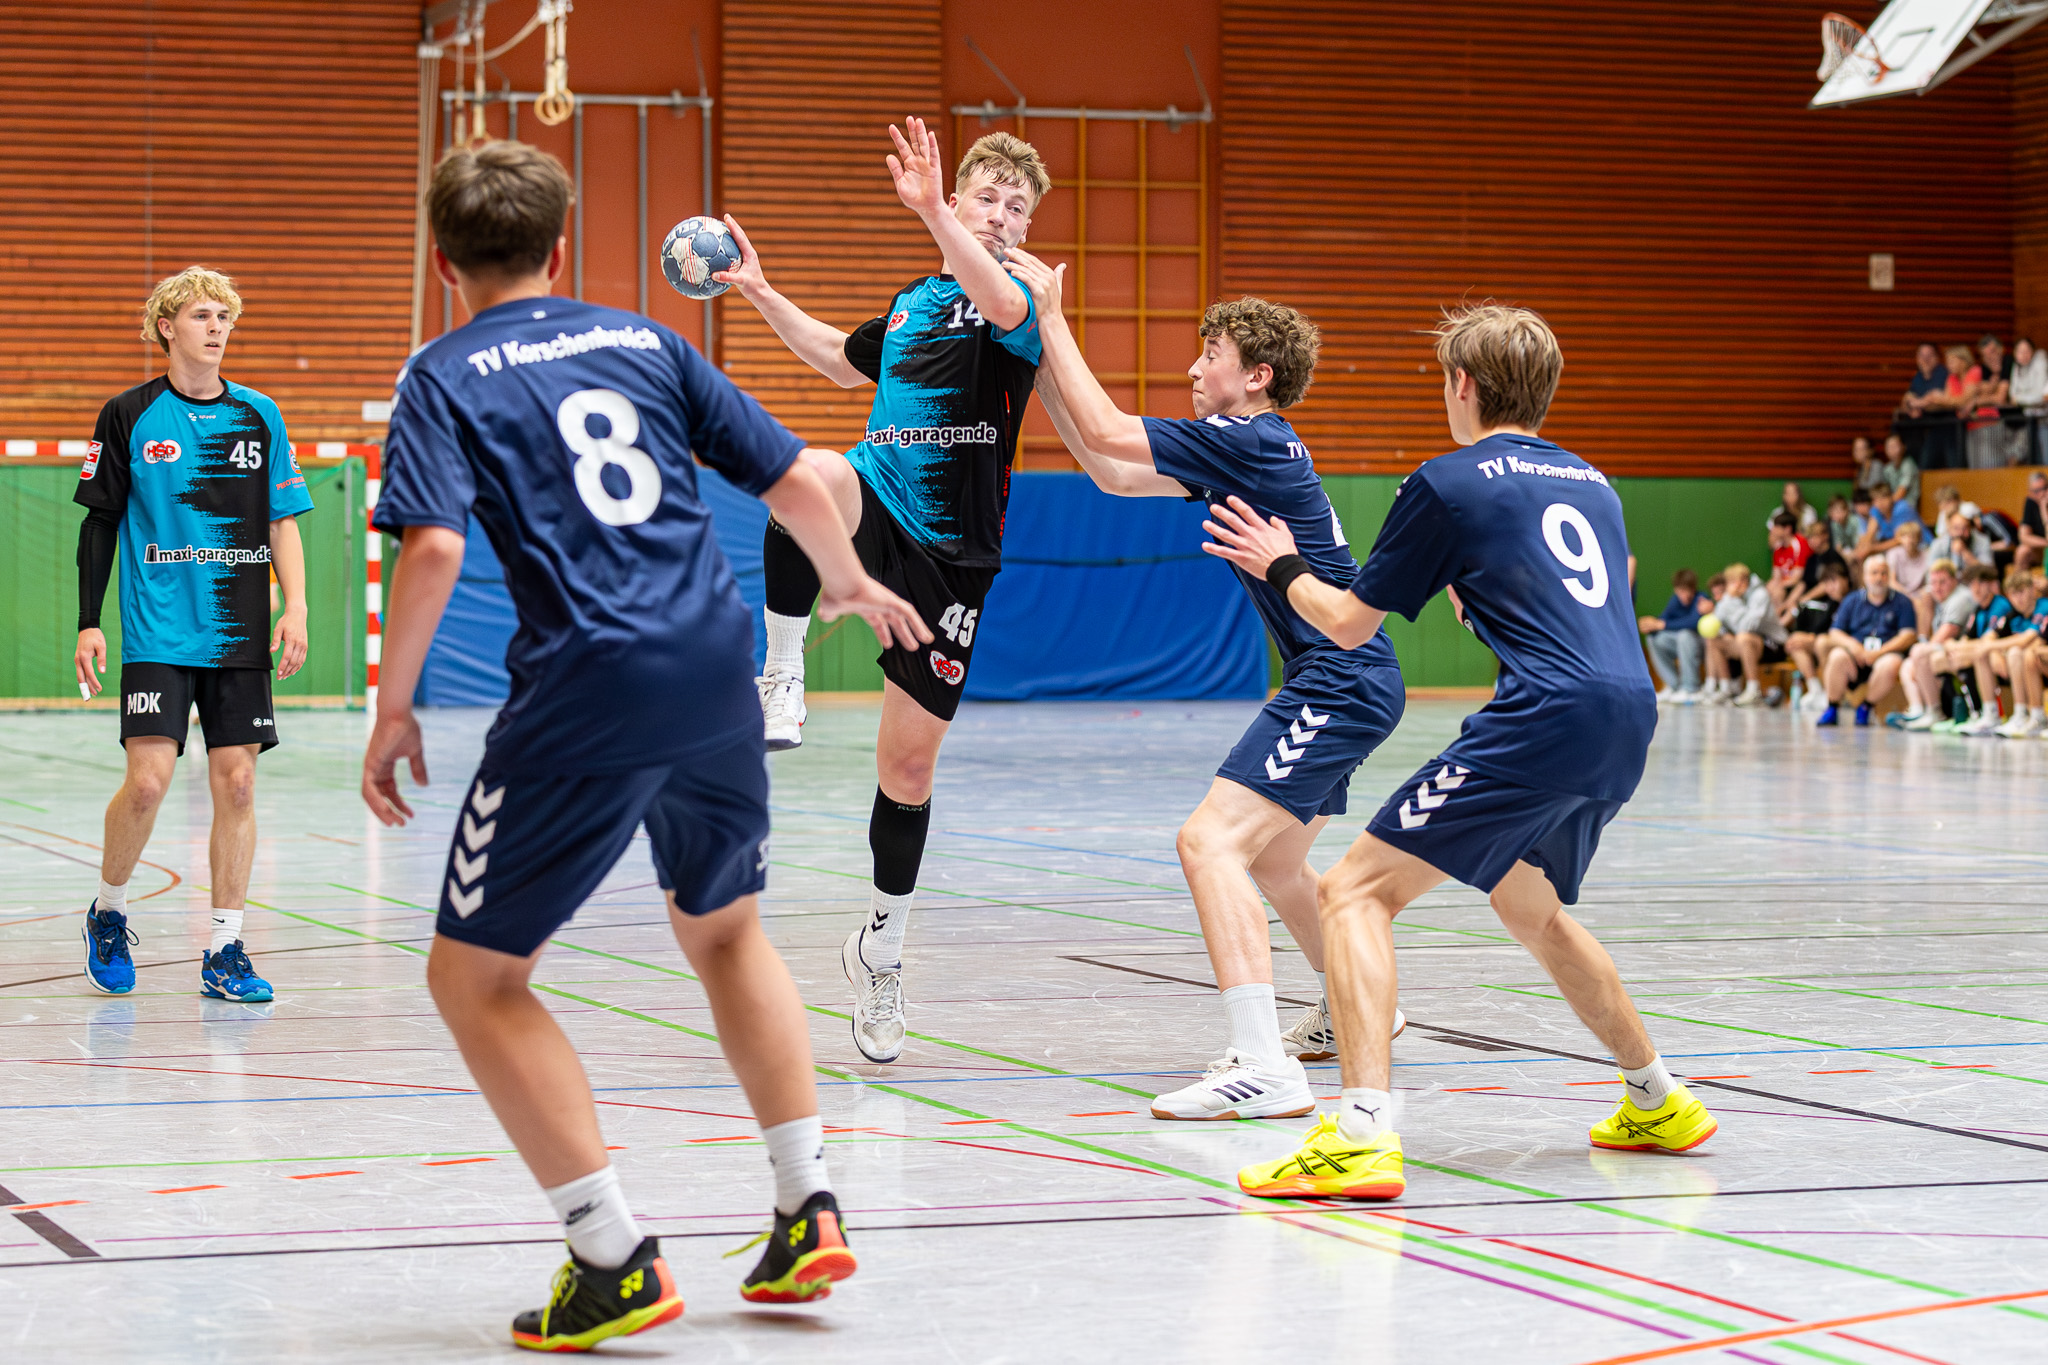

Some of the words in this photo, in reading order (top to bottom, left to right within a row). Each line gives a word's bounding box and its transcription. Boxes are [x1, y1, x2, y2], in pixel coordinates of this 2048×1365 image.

[947, 300, 986, 329] 14
[467, 346, 503, 377] TV
[501, 325, 662, 367] Korschenbroich
[147, 443, 176, 458] HSG
[229, 441, 262, 470] 45
[557, 388, 662, 527] 8
[1477, 457, 1505, 479] TV
[158, 545, 272, 566] maxi-garagen.de
[1542, 503, 1610, 609] 9
[938, 602, 978, 648] 45
[127, 692, 162, 715] MDK
